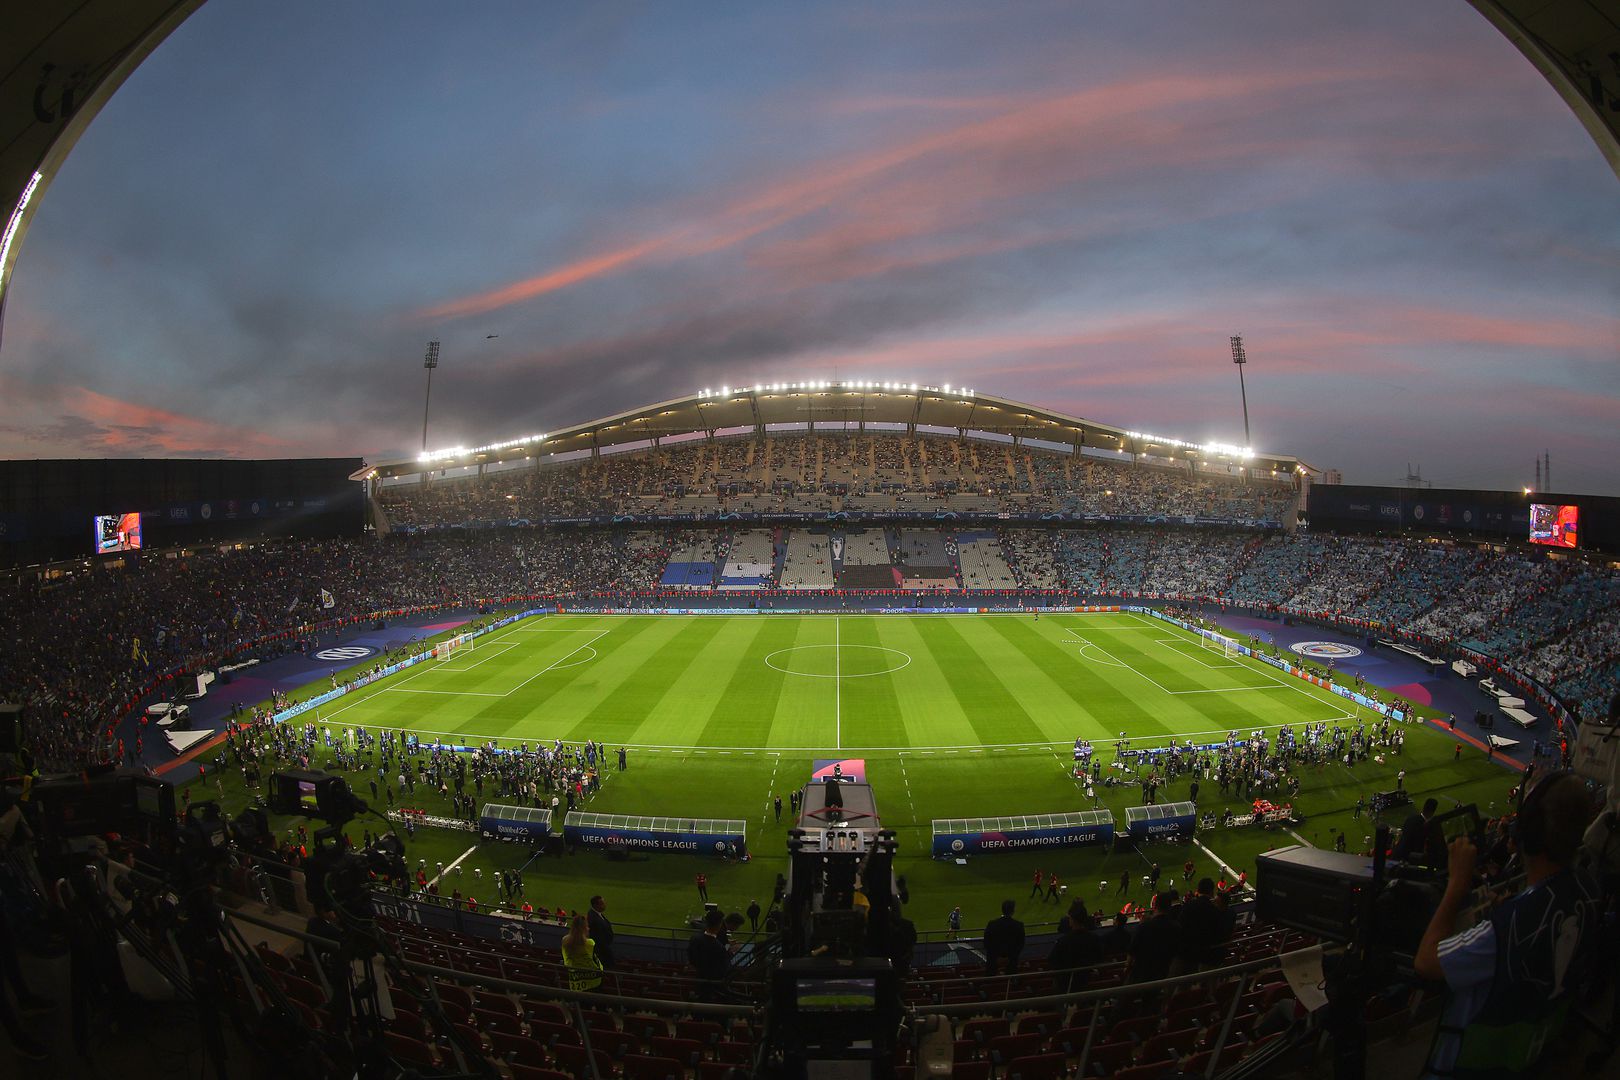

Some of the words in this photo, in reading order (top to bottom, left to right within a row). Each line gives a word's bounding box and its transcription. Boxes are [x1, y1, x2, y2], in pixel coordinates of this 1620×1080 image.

[1381, 505, 1399, 514] UEFA
[1259, 653, 1283, 668] mastercard
[1342, 688, 1356, 702] FedEx
[1365, 698, 1381, 712] FedEx
[582, 834, 605, 844] UEFA
[607, 836, 660, 848] CHAMPIONS
[662, 840, 698, 850] LEAGUE
[981, 840, 1006, 849] UEFA
[1007, 836, 1061, 847] CHAMPIONS
[1063, 833, 1096, 843] LEAGUE
